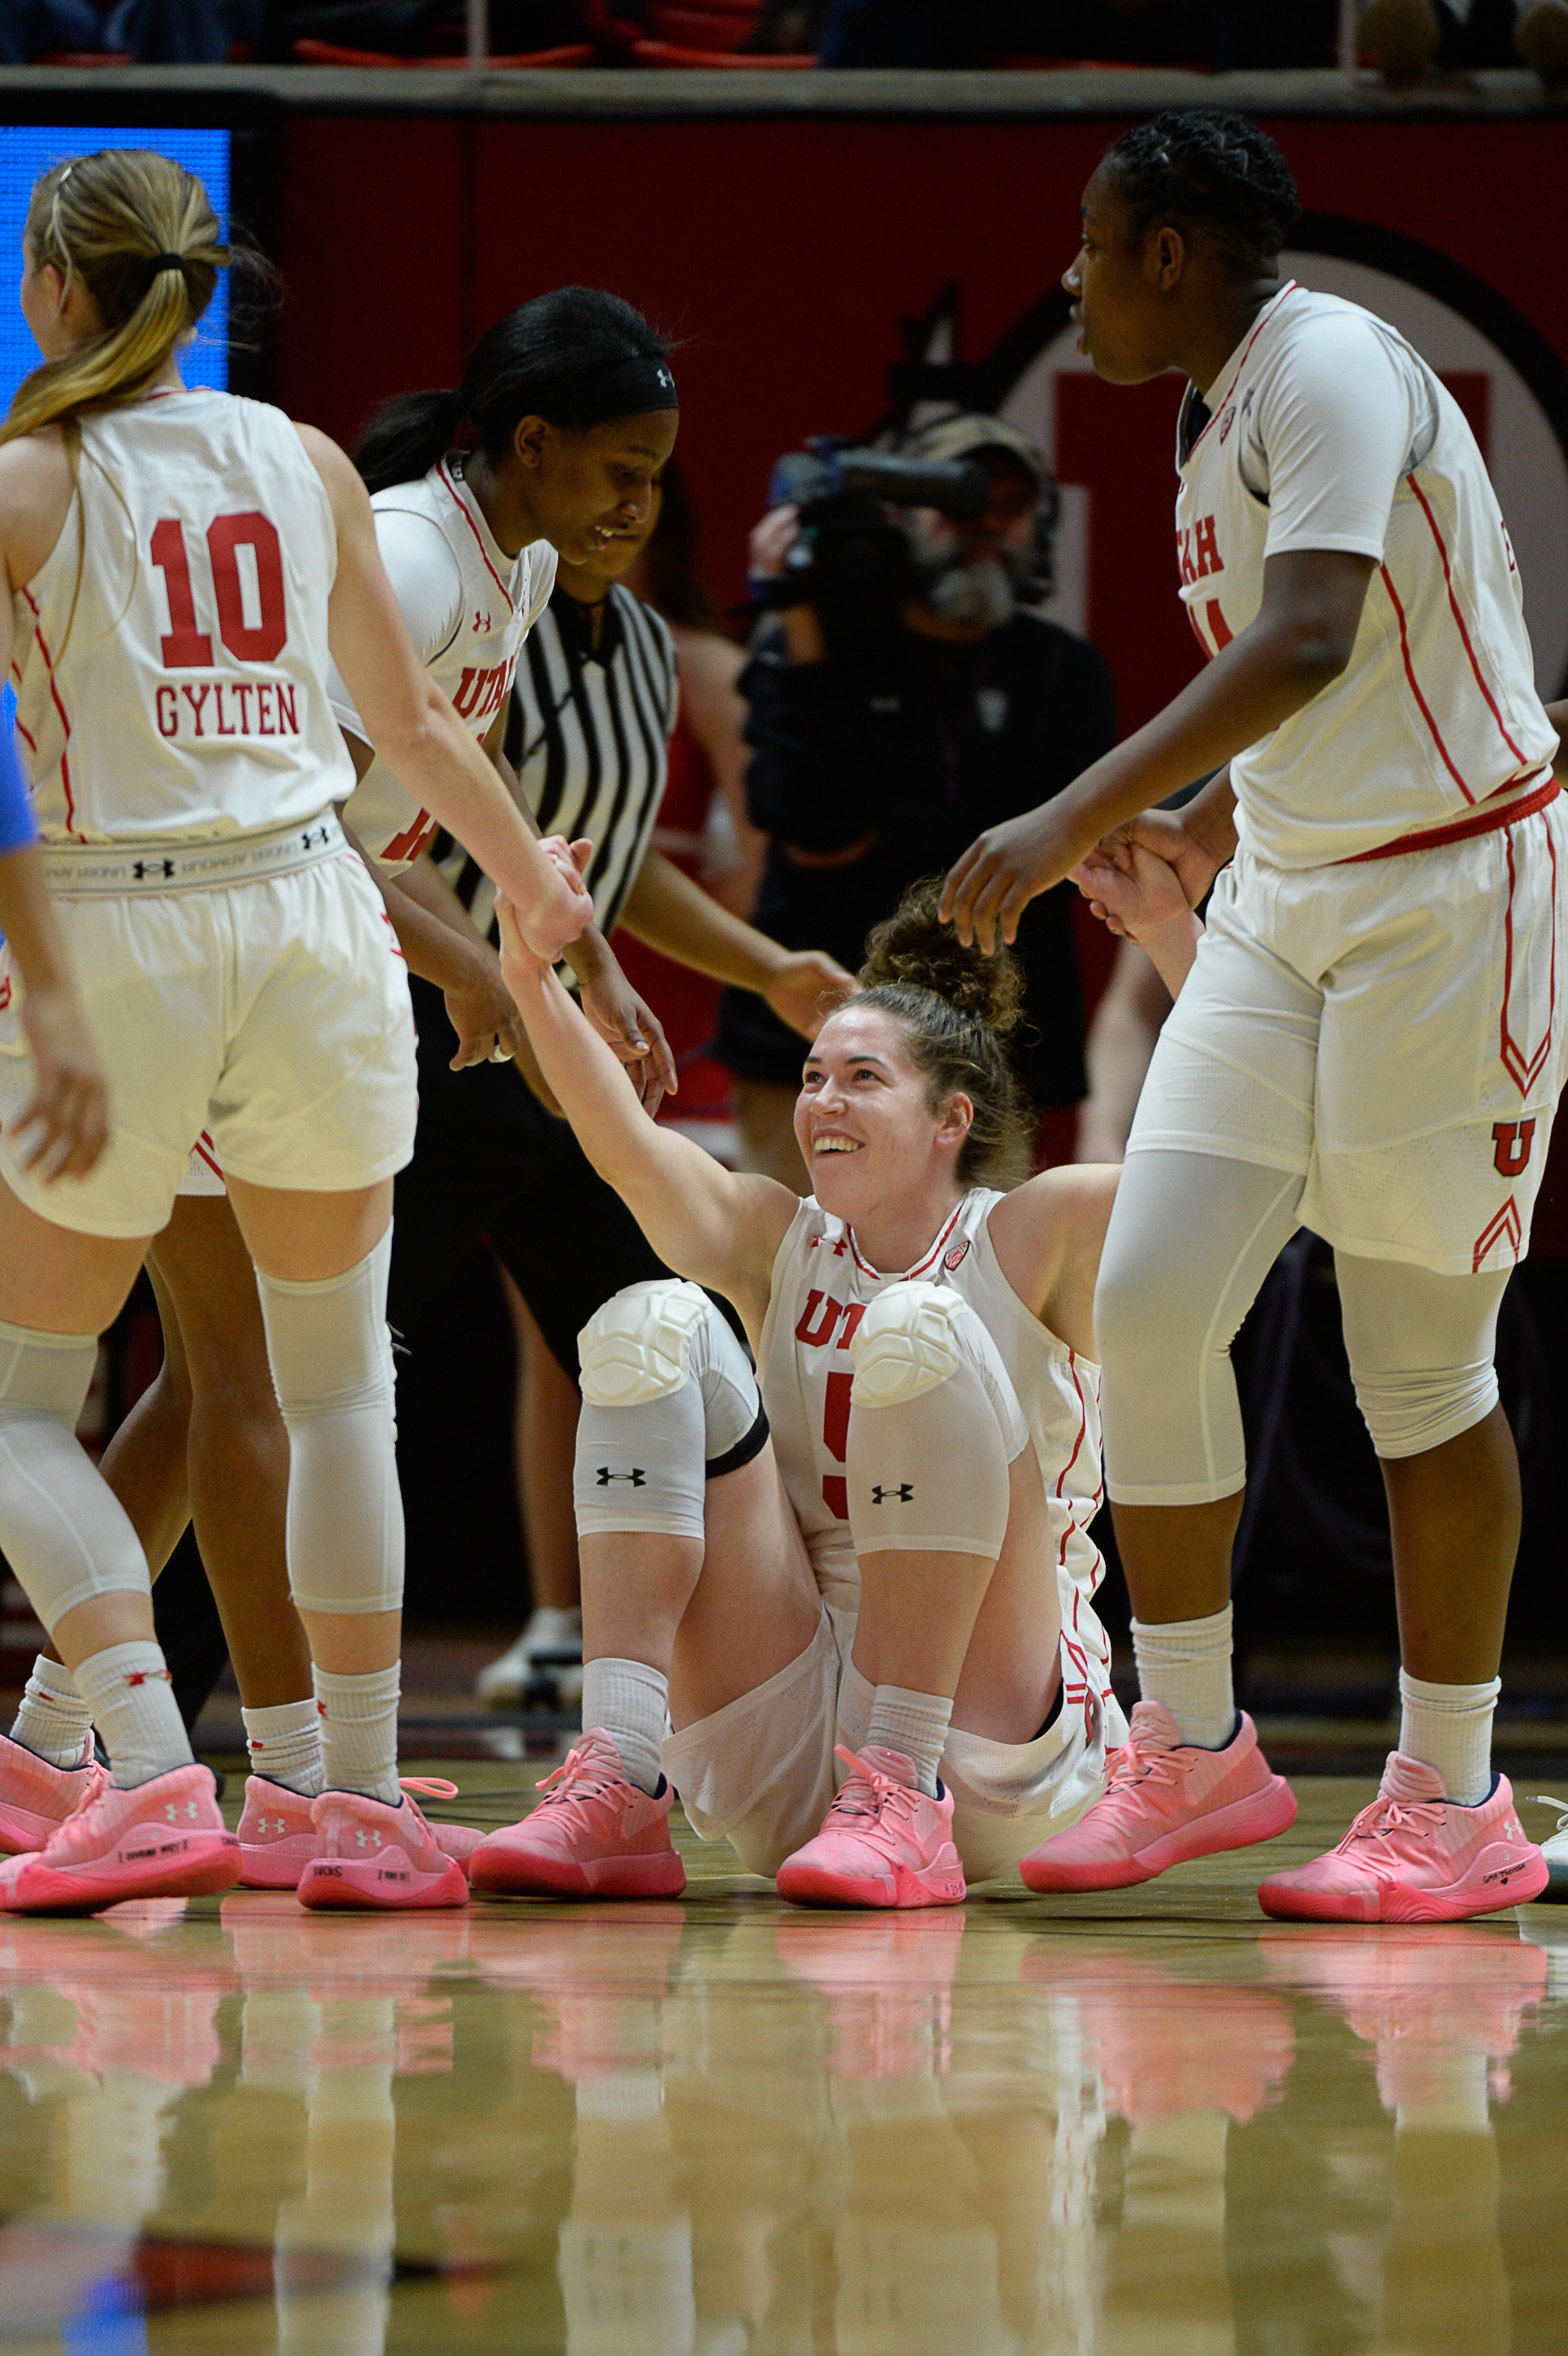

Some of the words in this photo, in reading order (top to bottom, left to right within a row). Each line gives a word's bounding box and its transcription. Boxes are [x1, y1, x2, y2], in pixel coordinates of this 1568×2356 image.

[150, 510, 288, 669] 10
[155, 681, 300, 738] GYLTEN
[452, 653, 515, 720] UTA
[77, 865, 127, 877] UNDER
[1492, 1116, 1537, 1177] U
